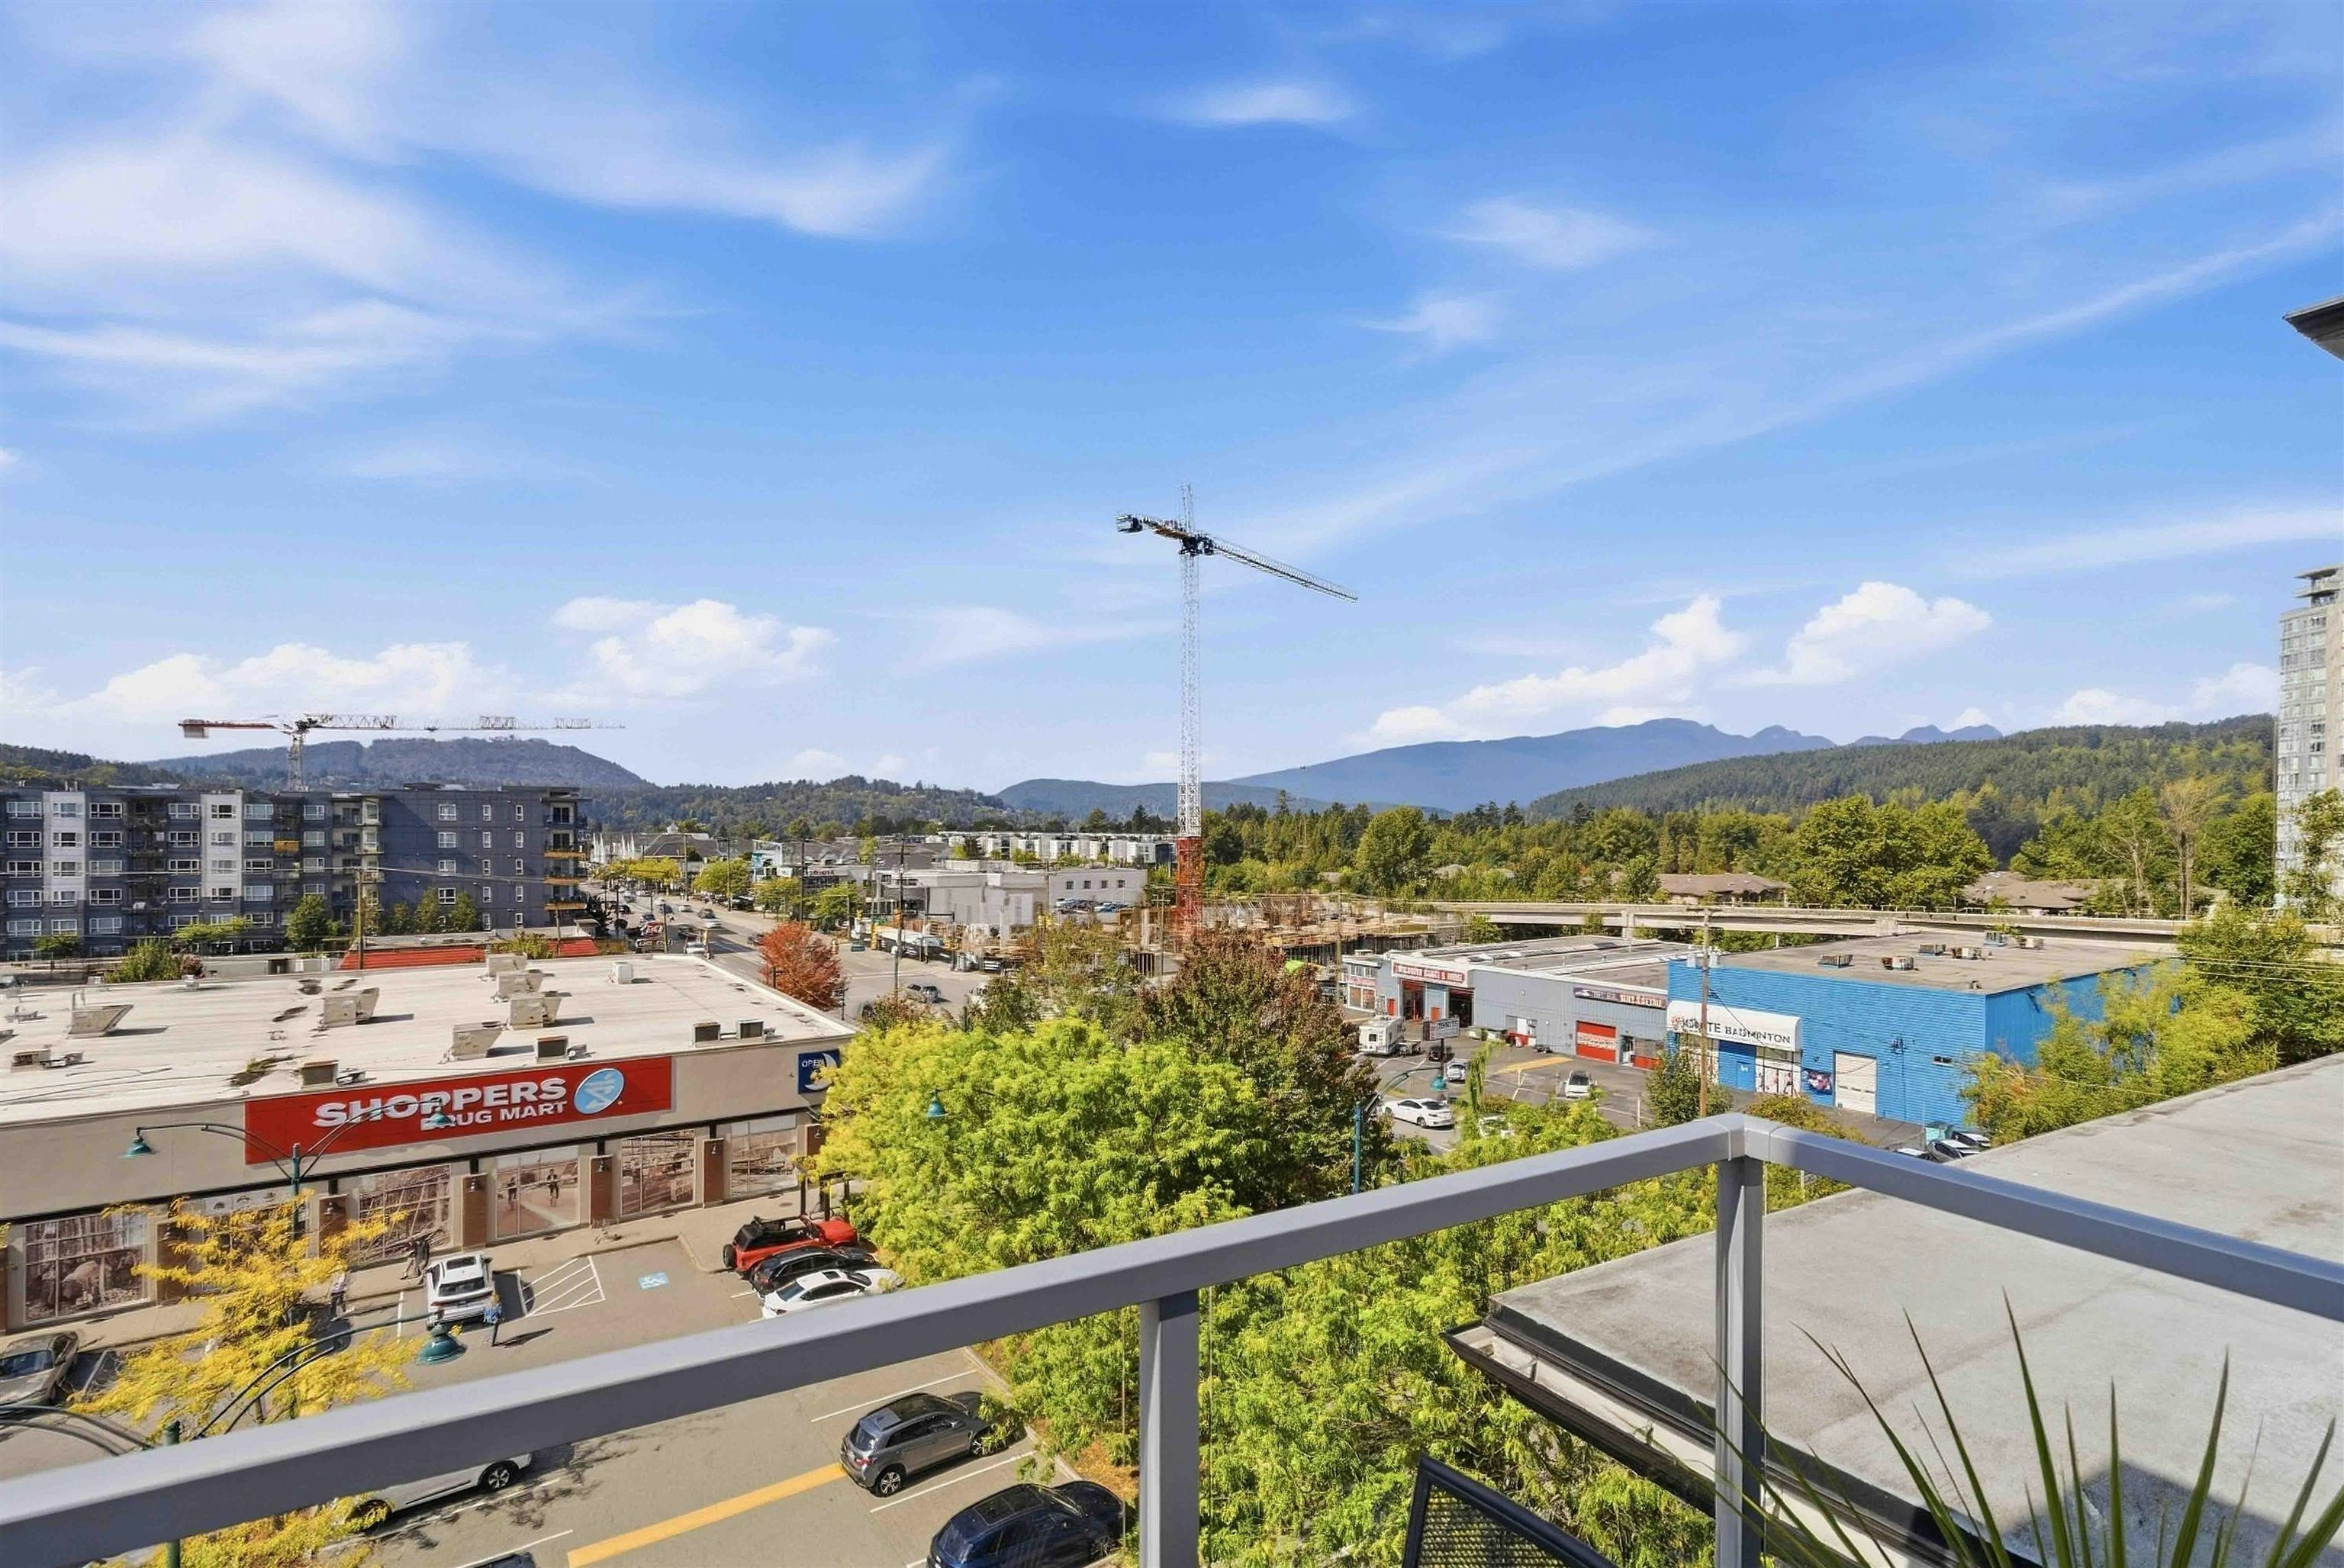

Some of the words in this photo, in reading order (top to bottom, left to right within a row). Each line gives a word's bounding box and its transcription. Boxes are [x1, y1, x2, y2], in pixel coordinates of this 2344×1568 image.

[1724, 1026, 1791, 1043] BADMINTON
[312, 1077, 567, 1128] SHOPPERS
[499, 1101, 568, 1121] MART
